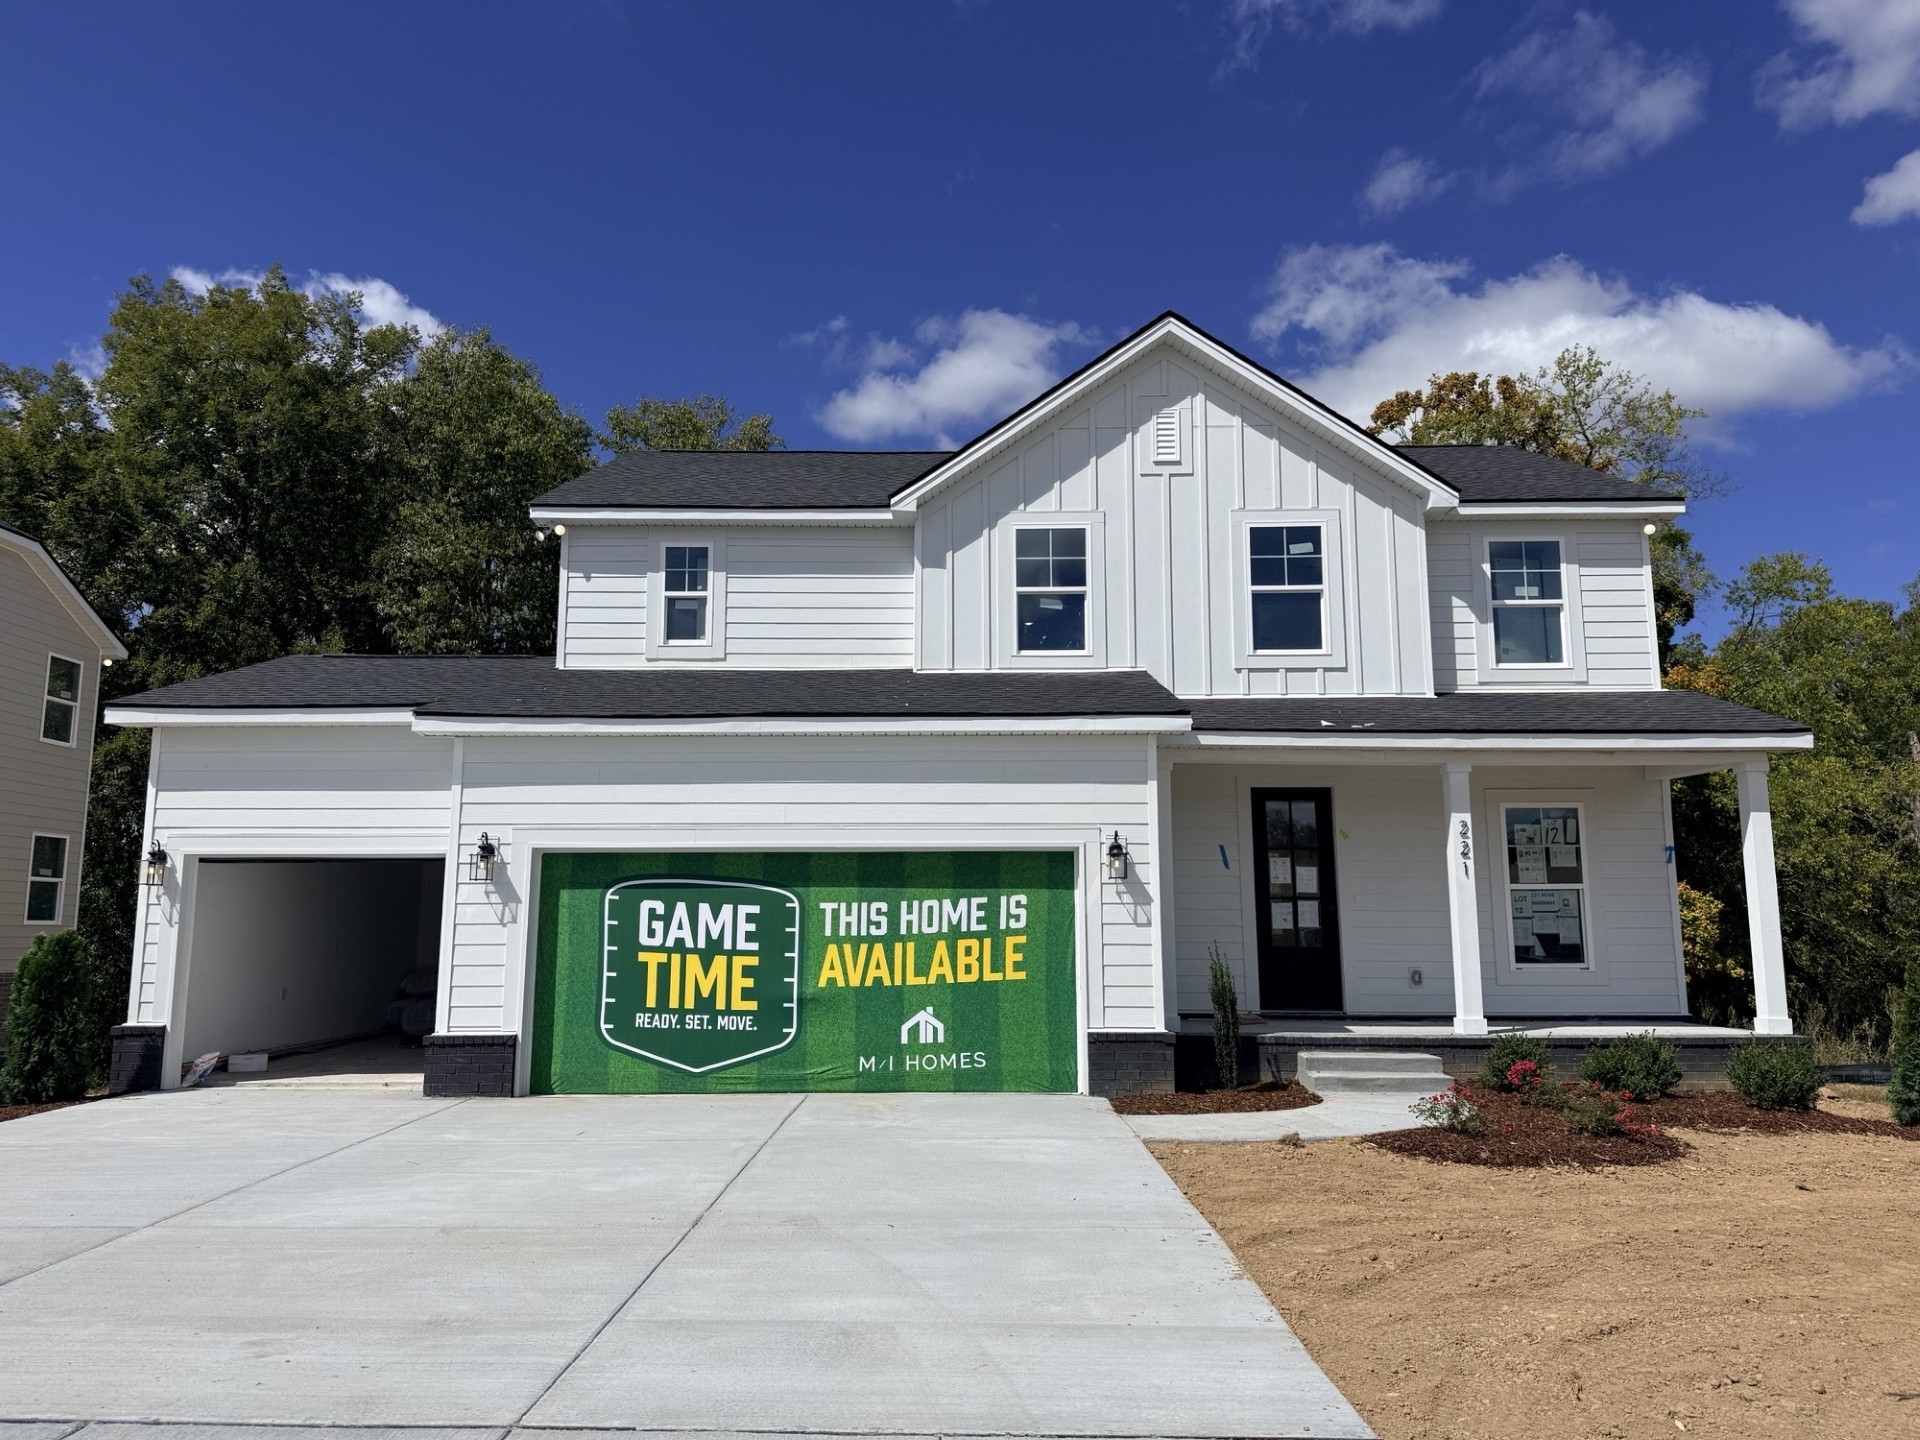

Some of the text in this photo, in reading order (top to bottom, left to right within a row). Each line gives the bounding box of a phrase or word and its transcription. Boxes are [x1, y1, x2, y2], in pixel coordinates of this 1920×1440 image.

[1459, 820, 1470, 880] 221
[1545, 827, 1561, 844] 12
[639, 900, 760, 950] GAME
[820, 894, 1028, 936] THIS HOME IS
[638, 952, 759, 1010] TIME
[818, 935, 1027, 987] AVAILABLE
[635, 1013, 758, 1030] READY. SET. MOVE.
[859, 1052, 986, 1072] M/I HOMES
